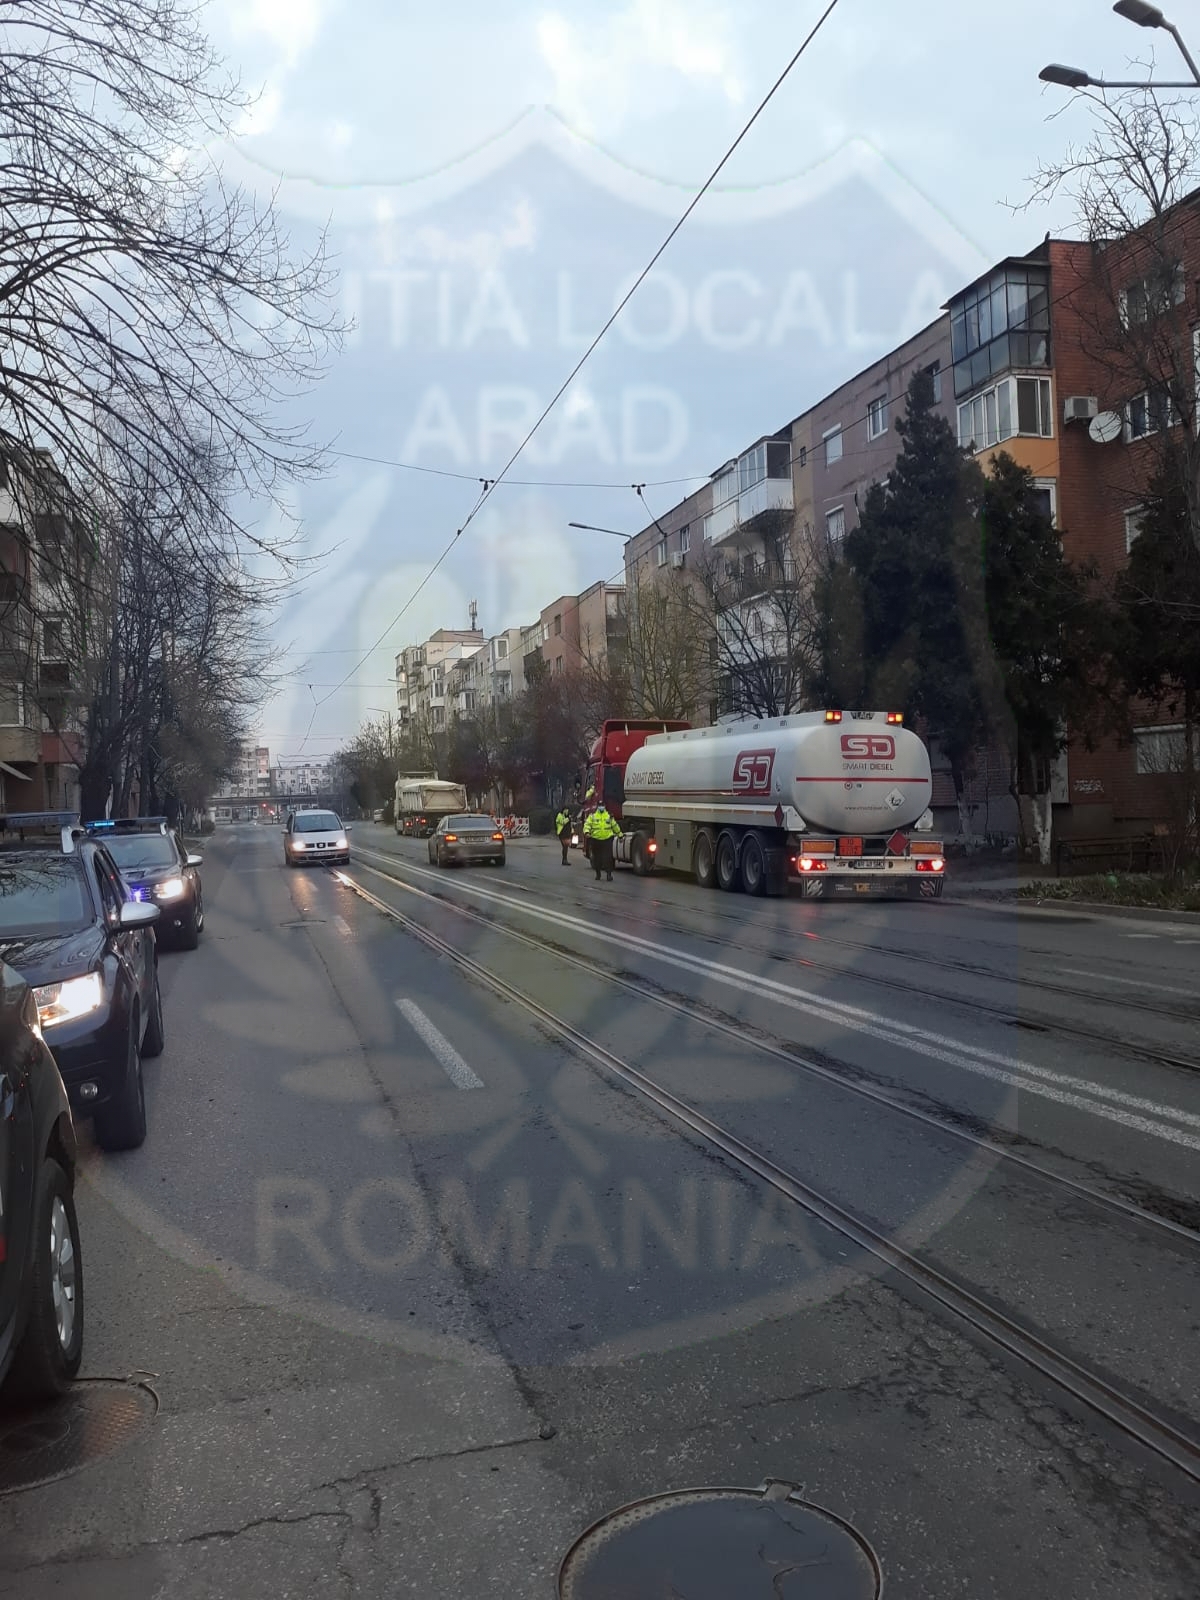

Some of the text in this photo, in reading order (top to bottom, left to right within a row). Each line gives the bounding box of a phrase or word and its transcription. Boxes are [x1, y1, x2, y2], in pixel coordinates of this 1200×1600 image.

[842, 738, 892, 756] SD
[733, 756, 771, 789] SD
[869, 763, 894, 771] DIESEL
[647, 771, 665, 785] DIESEL
